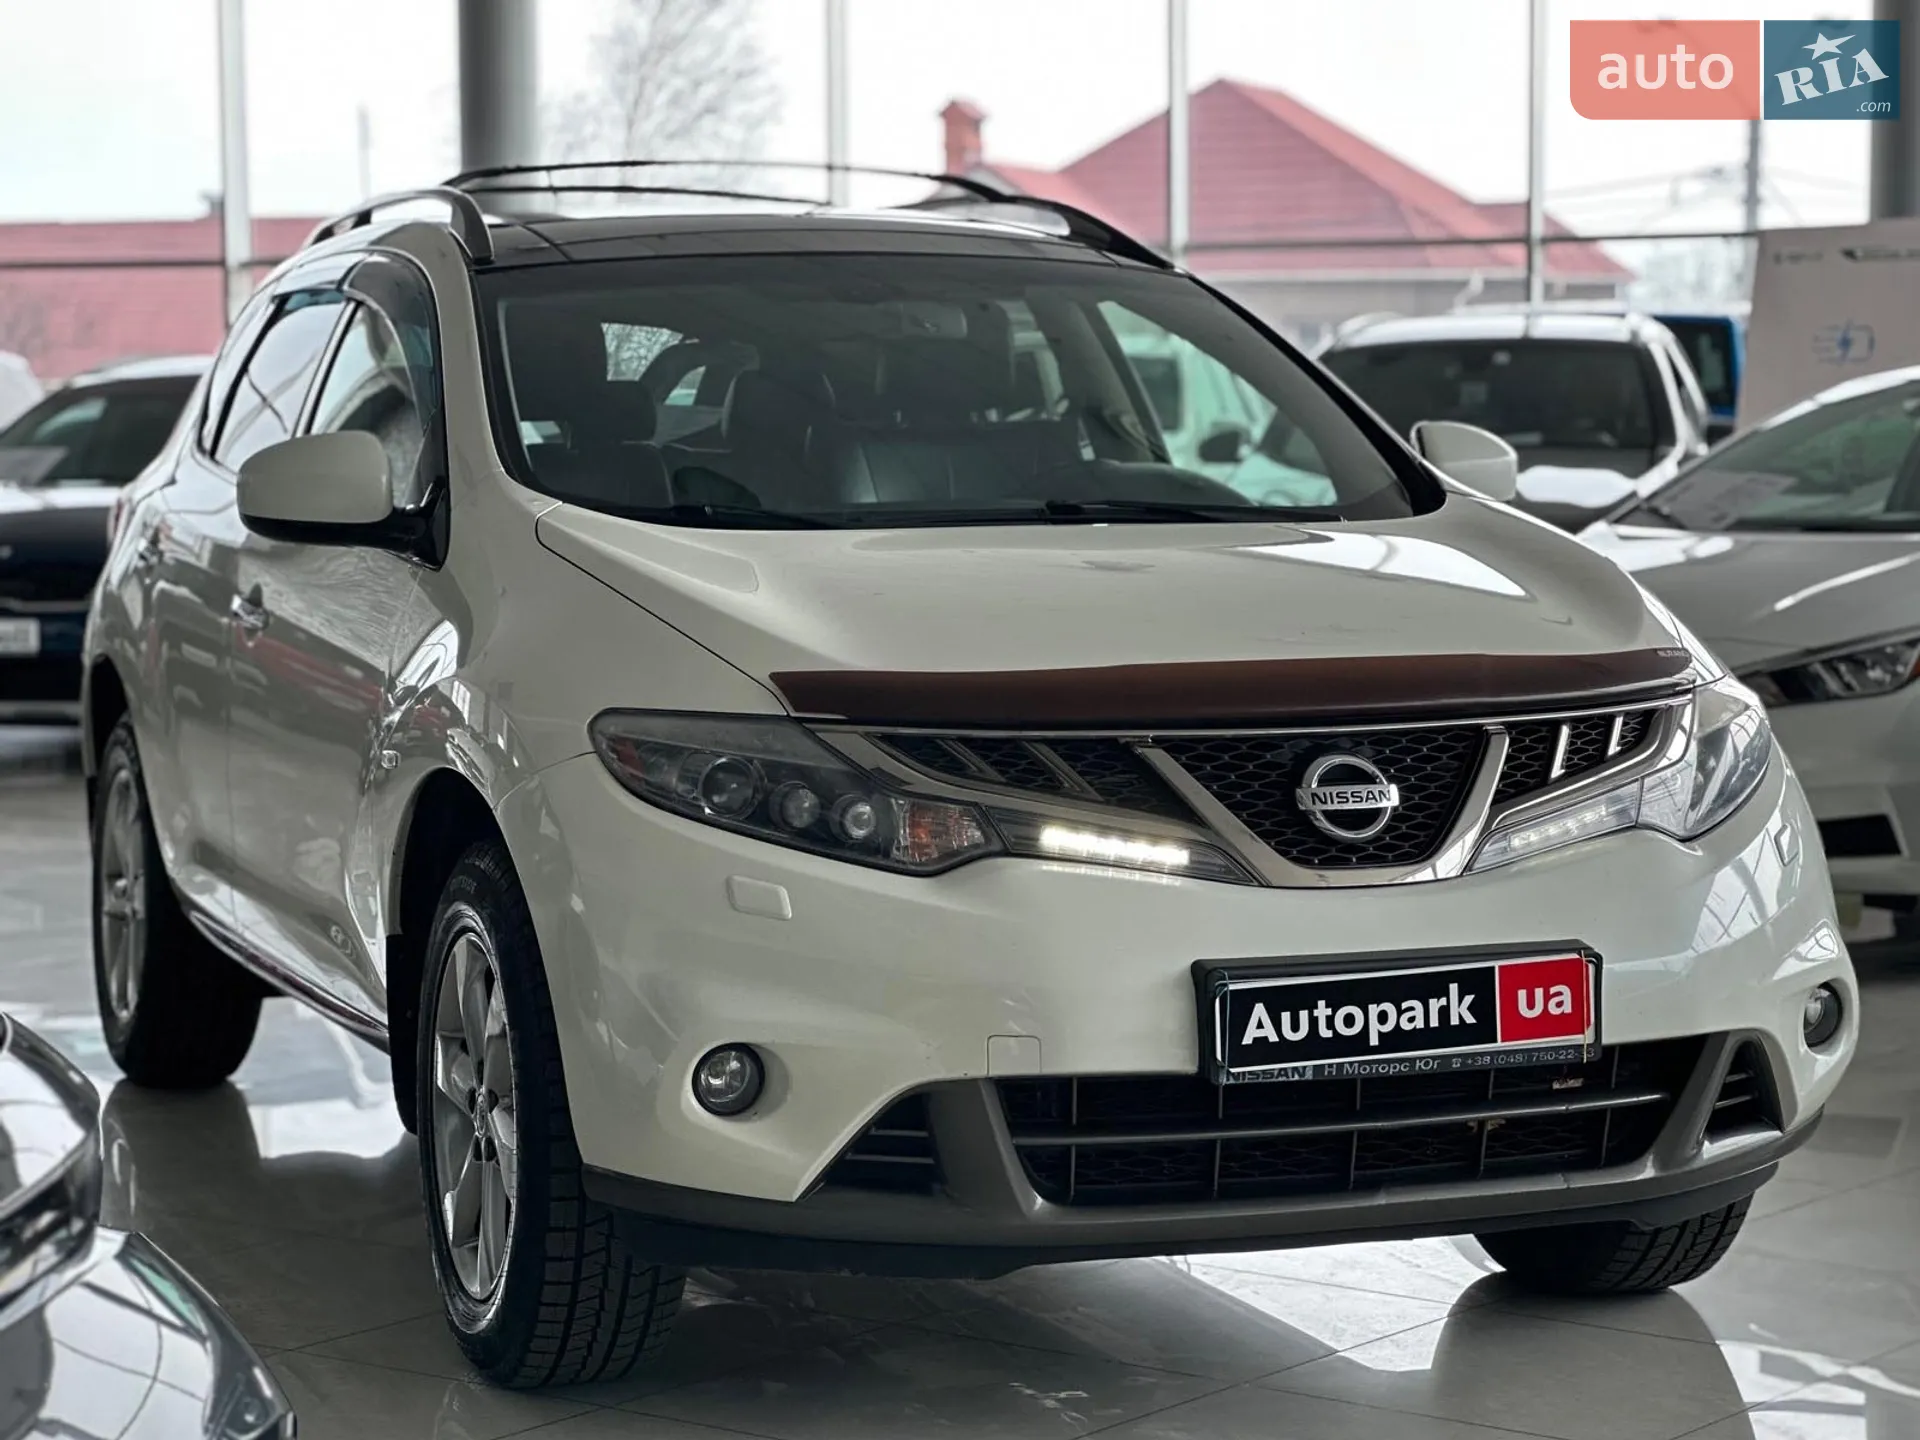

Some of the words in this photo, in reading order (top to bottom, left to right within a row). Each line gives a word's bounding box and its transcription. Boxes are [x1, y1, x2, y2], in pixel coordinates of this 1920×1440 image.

[1311, 790, 1391, 805] NISSAN
[1241, 983, 1478, 1046] Autopark
[1517, 984, 1573, 1018] ua
[1226, 1065, 1306, 1083] NISSAN
[1343, 1058, 1411, 1078] Моторс
[1415, 1058, 1441, 1074] Юг
